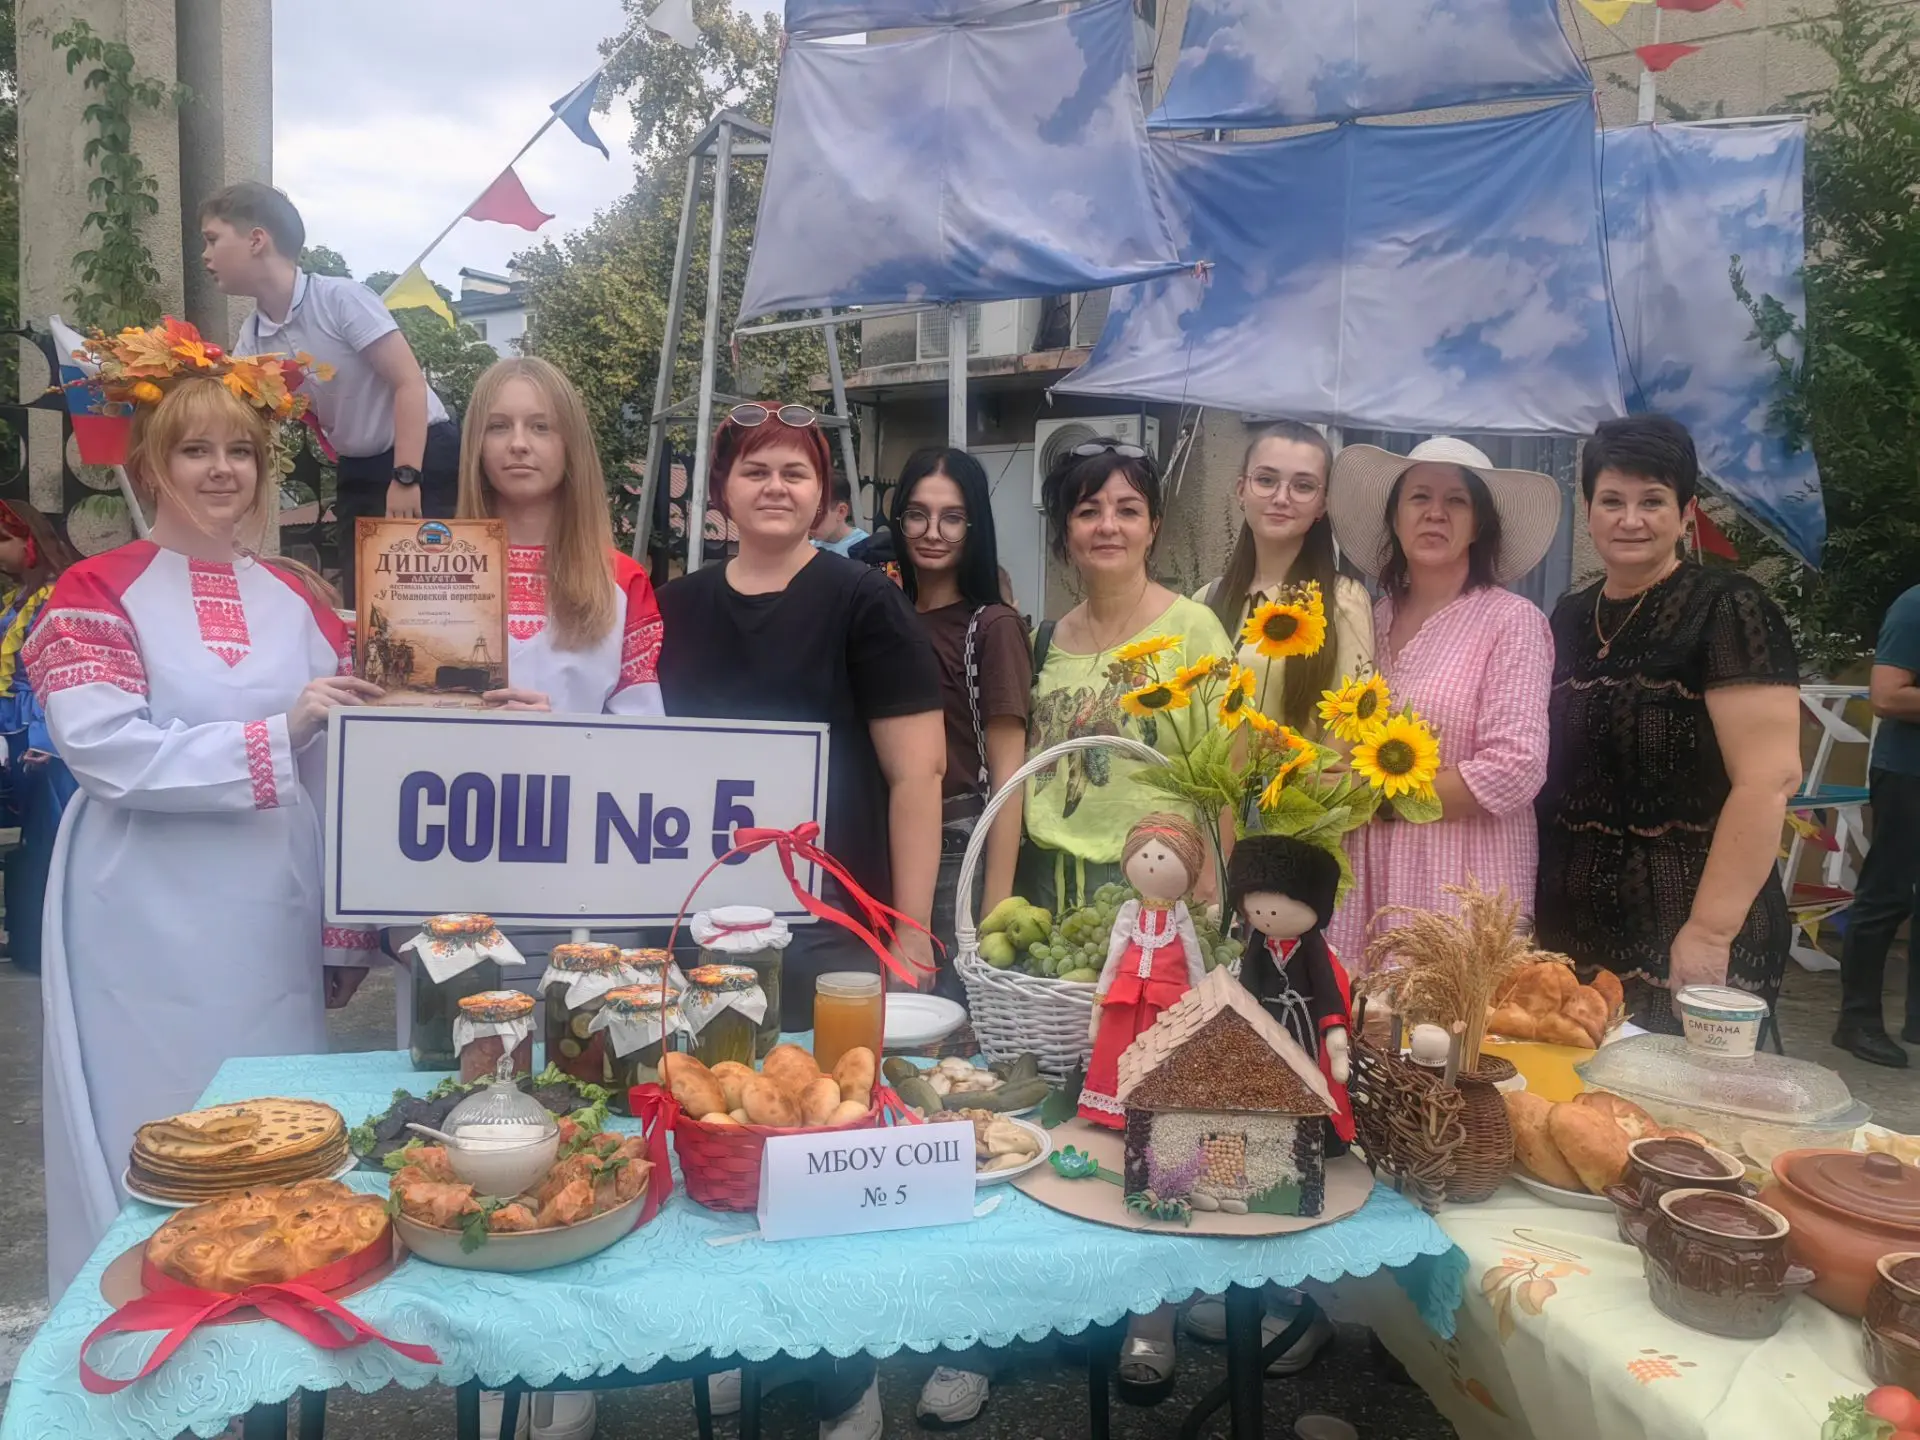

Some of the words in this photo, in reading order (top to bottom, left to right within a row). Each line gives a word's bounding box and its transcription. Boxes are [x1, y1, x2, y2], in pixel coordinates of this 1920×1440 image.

[374, 554, 488, 575] ДИПЛОМ
[390, 589, 448, 601] Романовской
[398, 771, 571, 864] СОШ
[594, 791, 691, 864] №
[711, 779, 755, 866] 5
[1688, 1020, 1740, 1035] СМЕТАНА
[807, 1146, 887, 1175] МБОУ
[895, 1139, 961, 1167] СОШ
[860, 1186, 887, 1208] №
[895, 1184, 908, 1205] 5
